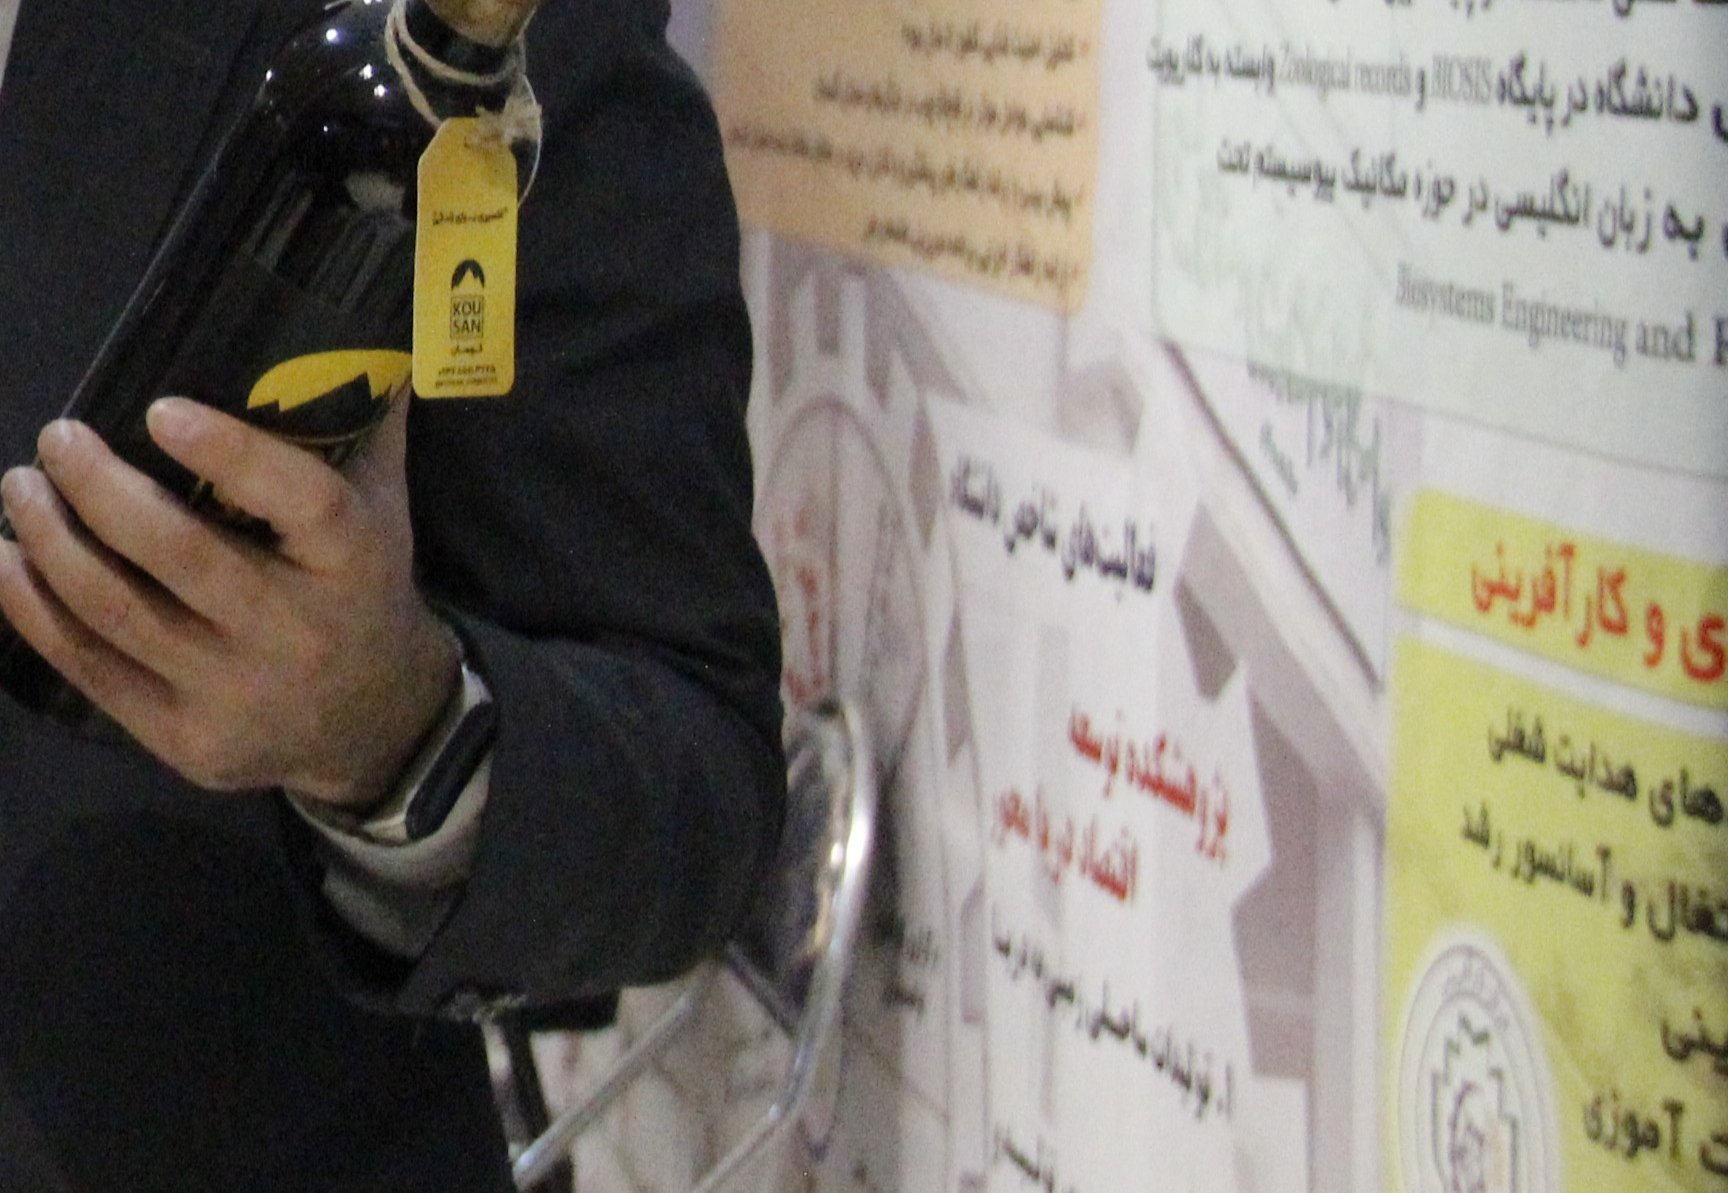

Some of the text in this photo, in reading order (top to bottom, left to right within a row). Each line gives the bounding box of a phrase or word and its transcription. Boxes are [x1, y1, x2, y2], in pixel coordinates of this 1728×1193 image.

[1415, 65, 1427, 114] و
[1497, 50, 1556, 139] پایگاه
[1561, 76, 1589, 128] در
[1596, 55, 1699, 122] دانشگاه
[1343, 148, 1408, 210] مکانیک
[1412, 158, 1455, 221] حوزه
[1462, 172, 1489, 227] در
[1495, 168, 1591, 235] انگلیسی
[1598, 183, 1652, 254] زبان
[1663, 202, 1705, 261] به
[451, 317, 482, 335] SAN
[1502, 279, 1629, 369] Engineering
[1636, 310, 1697, 364] and
[1645, 600, 1665, 669] و
[1487, 705, 1547, 764] شغلی
[1554, 732, 1637, 803] هدایت
[1511, 839, 1612, 905] آسانسور
[1620, 878, 1637, 930] و
